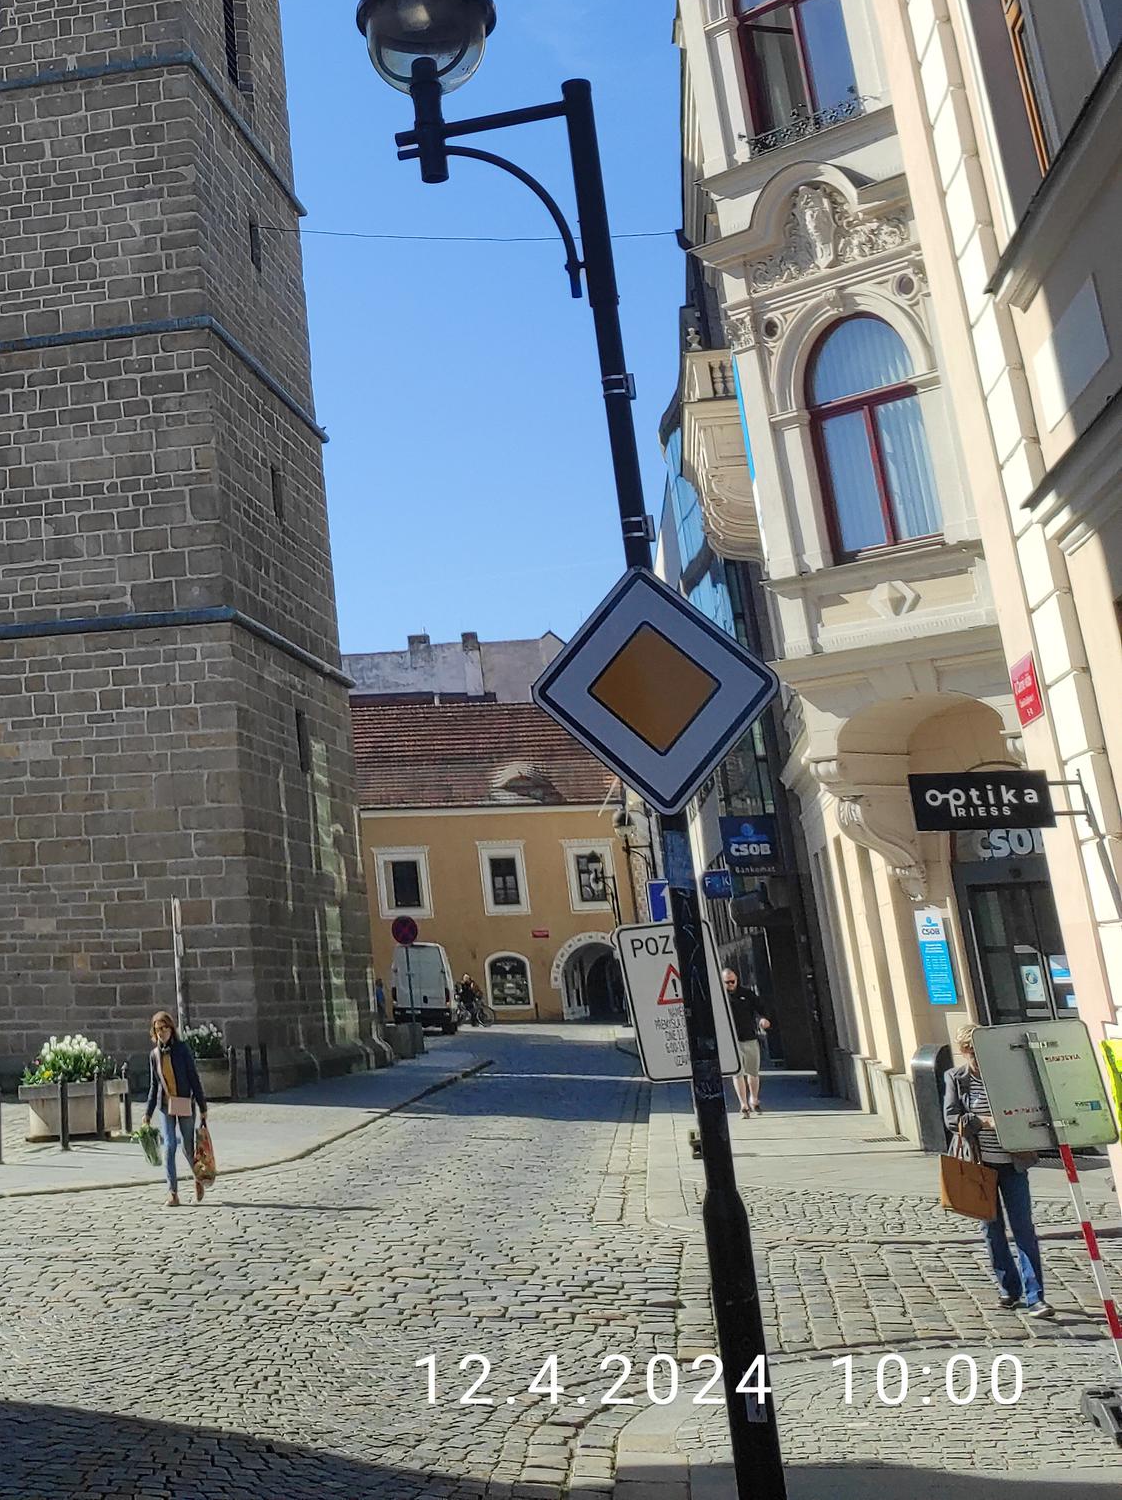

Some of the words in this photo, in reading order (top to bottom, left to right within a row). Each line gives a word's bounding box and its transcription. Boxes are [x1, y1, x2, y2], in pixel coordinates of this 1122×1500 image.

[925, 784, 1039, 818] optika
[957, 806, 1012, 818] RIESS
[630, 935, 674, 958] POZ
